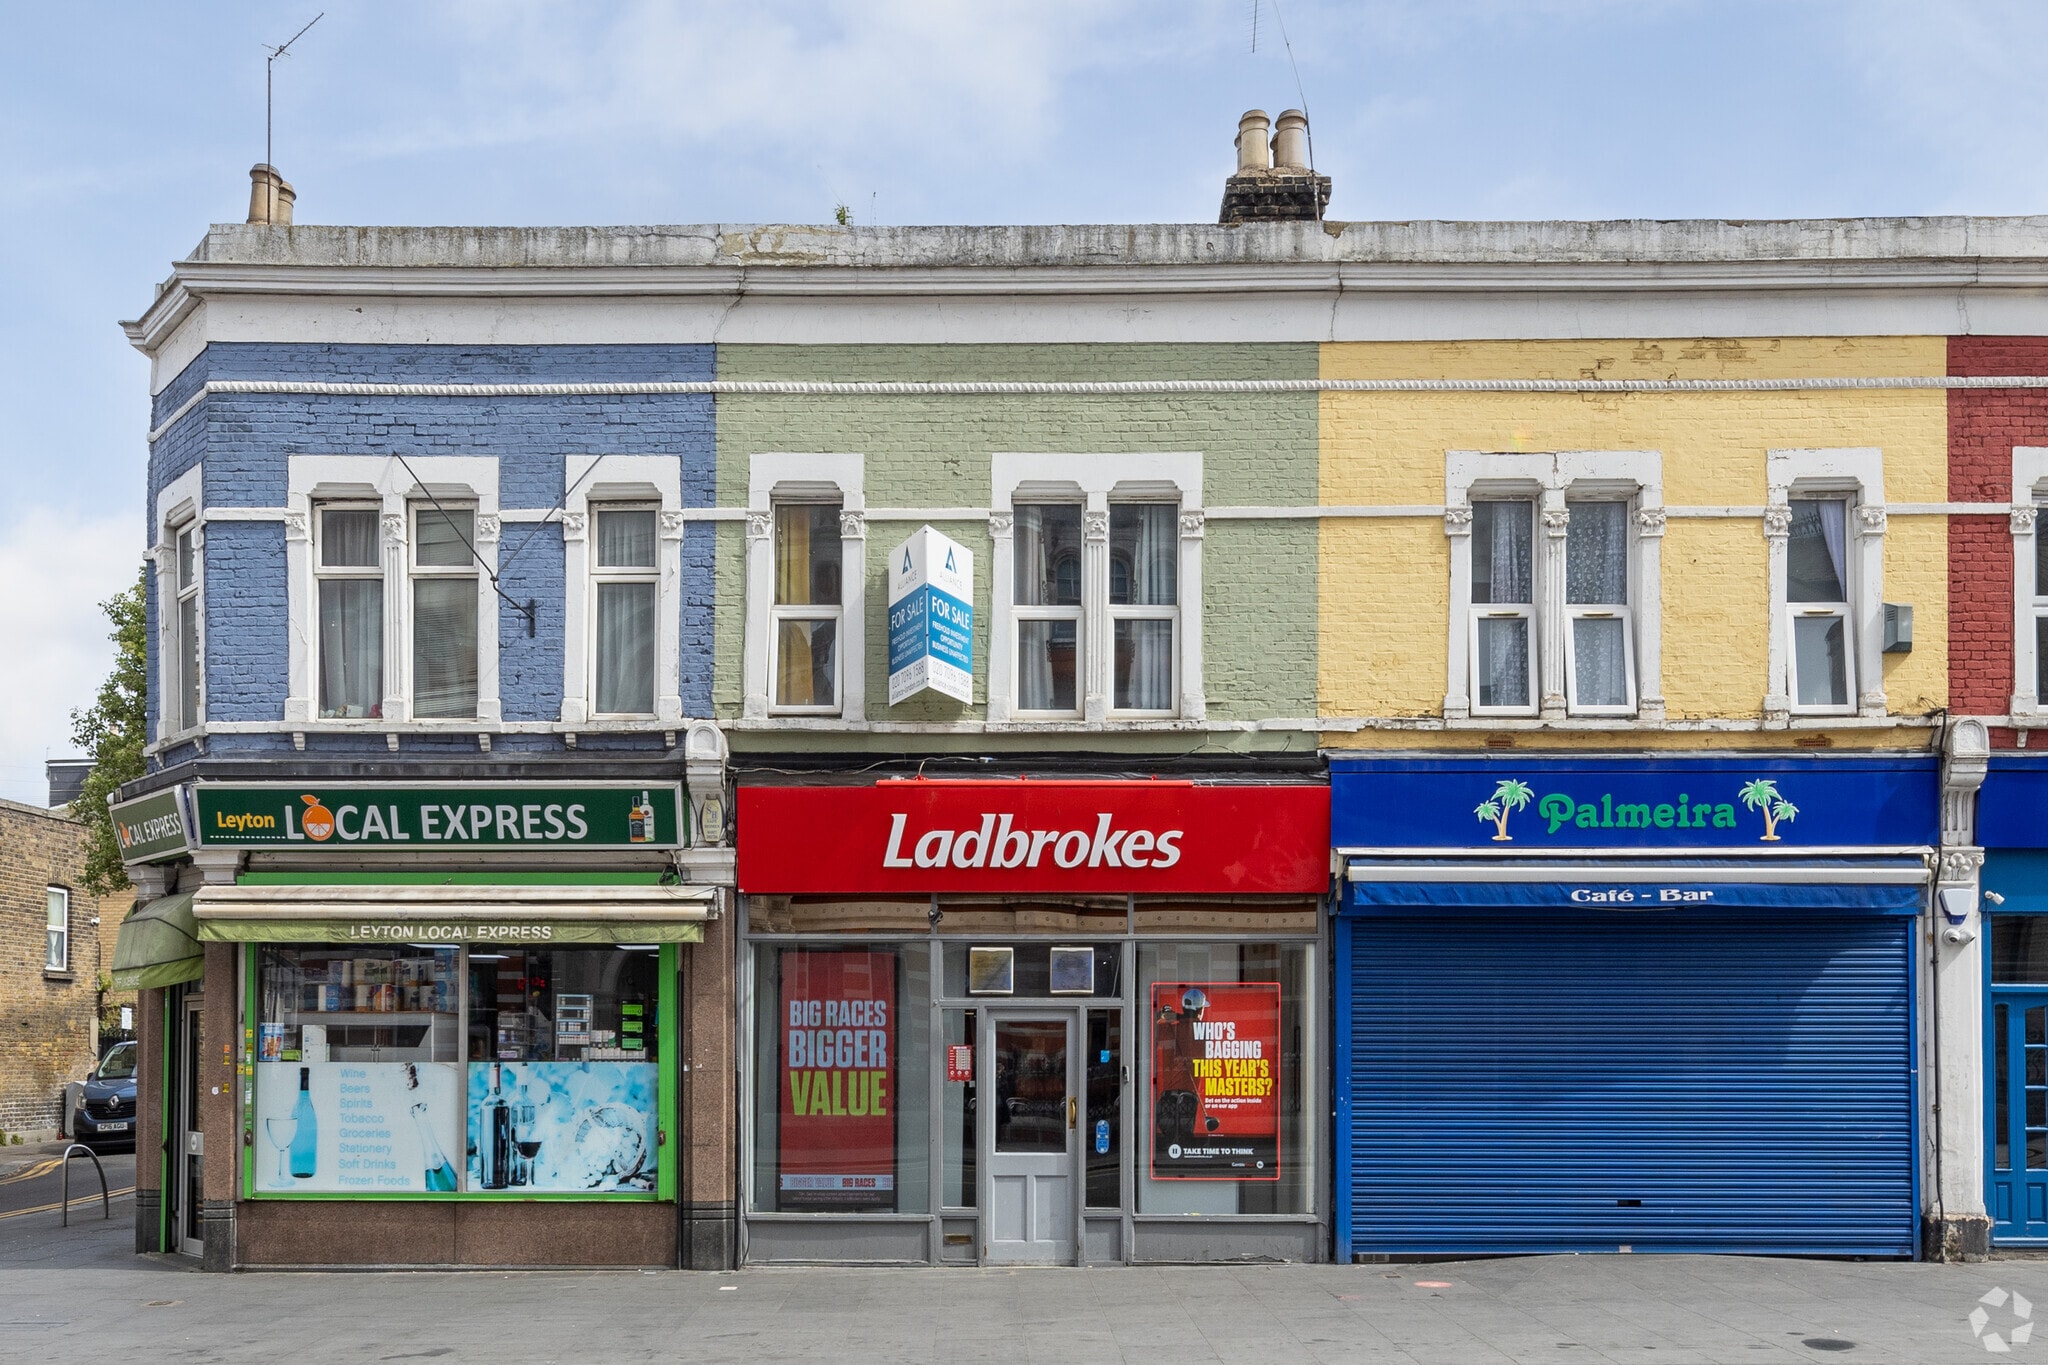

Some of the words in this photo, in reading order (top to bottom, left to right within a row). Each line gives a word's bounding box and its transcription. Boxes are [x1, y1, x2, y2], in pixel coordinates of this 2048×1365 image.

[891, 608, 906, 631] FOR
[906, 596, 924, 620] SALE
[931, 595, 950, 620] FOR
[951, 606, 970, 630] SALE
[217, 811, 275, 831] Leyton
[285, 803, 410, 841] LOCAL
[420, 803, 588, 840] EXPRESS
[1538, 793, 1736, 834] Palmeira
[146, 812, 183, 842] EXPRESS
[883, 813, 1184, 868] Ladbrokes
[1570, 888, 1634, 902] Café
[1659, 889, 1714, 901] Bar
[350, 925, 413, 939] LEYTON
[418, 925, 472, 940] LOCAL
[477, 925, 552, 939] EXPRESS
[789, 1000, 822, 1027] BIG
[825, 1000, 887, 1027] RACES
[1193, 1022, 1235, 1040] WHO'S
[788, 1030, 887, 1068] BIGGER
[1205, 1040, 1262, 1059] BAGGING
[340, 1069, 367, 1079] Wine
[1193, 1059, 1222, 1077] THIS
[1224, 1059, 1269, 1077] YEAR'S
[340, 1084, 371, 1094] Beers
[789, 1071, 887, 1116] VALUE
[1205, 1078, 1273, 1096] MASTERS?
[339, 1098, 373, 1111] Spirits
[340, 1112, 385, 1124] Tobacco
[339, 1128, 392, 1139] Groceries
[339, 1142, 393, 1156] Stationery
[338, 1158, 360, 1170] Soft
[363, 1158, 397, 1170] Drinks
[338, 1174, 374, 1186] Frozen
[377, 1174, 411, 1187] Foods
[842, 1177, 854, 1188] BIG
[854, 1177, 877, 1188] RACES
